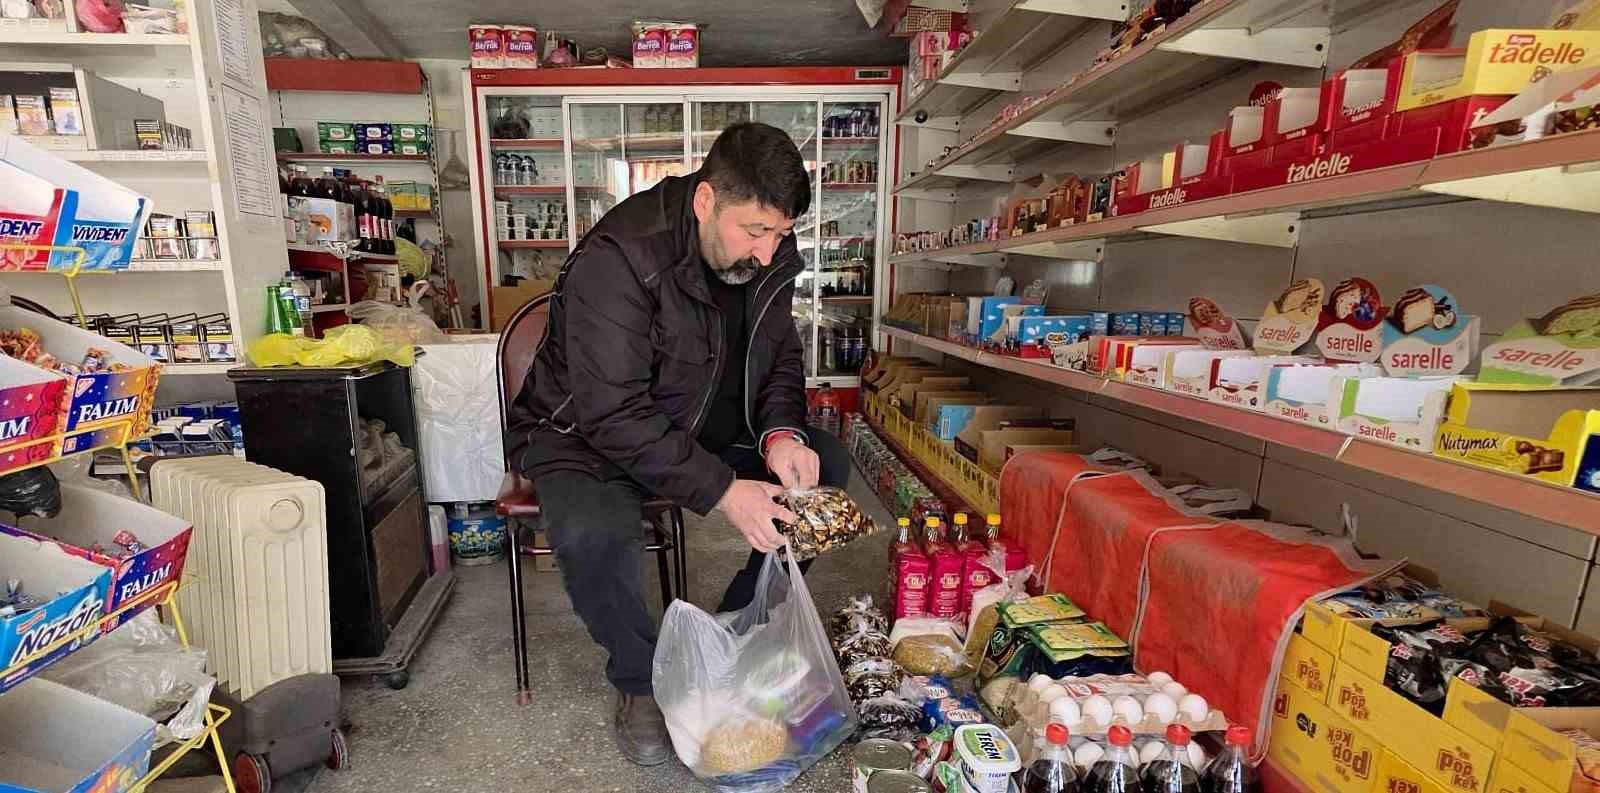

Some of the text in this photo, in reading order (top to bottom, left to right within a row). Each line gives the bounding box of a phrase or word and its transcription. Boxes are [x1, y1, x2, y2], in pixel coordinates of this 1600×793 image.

[1488, 42, 1585, 64] tadelle
[1287, 153, 1351, 183] tadelle
[1149, 187, 1186, 208] tadelle
[73, 226, 128, 241] VIVIDENT
[1259, 326, 1300, 343] sarelle
[1327, 333, 1373, 353] sarelle
[1391, 347, 1453, 370] sarelle
[1493, 347, 1584, 371] sarelle
[79, 395, 138, 423] FALIM
[1281, 406, 1309, 420] sarelle
[1359, 422, 1397, 442] sarelle
[1439, 432, 1499, 456] Nutymax
[121, 563, 171, 601] FALIM
[975, 732, 1002, 759] TEREM
